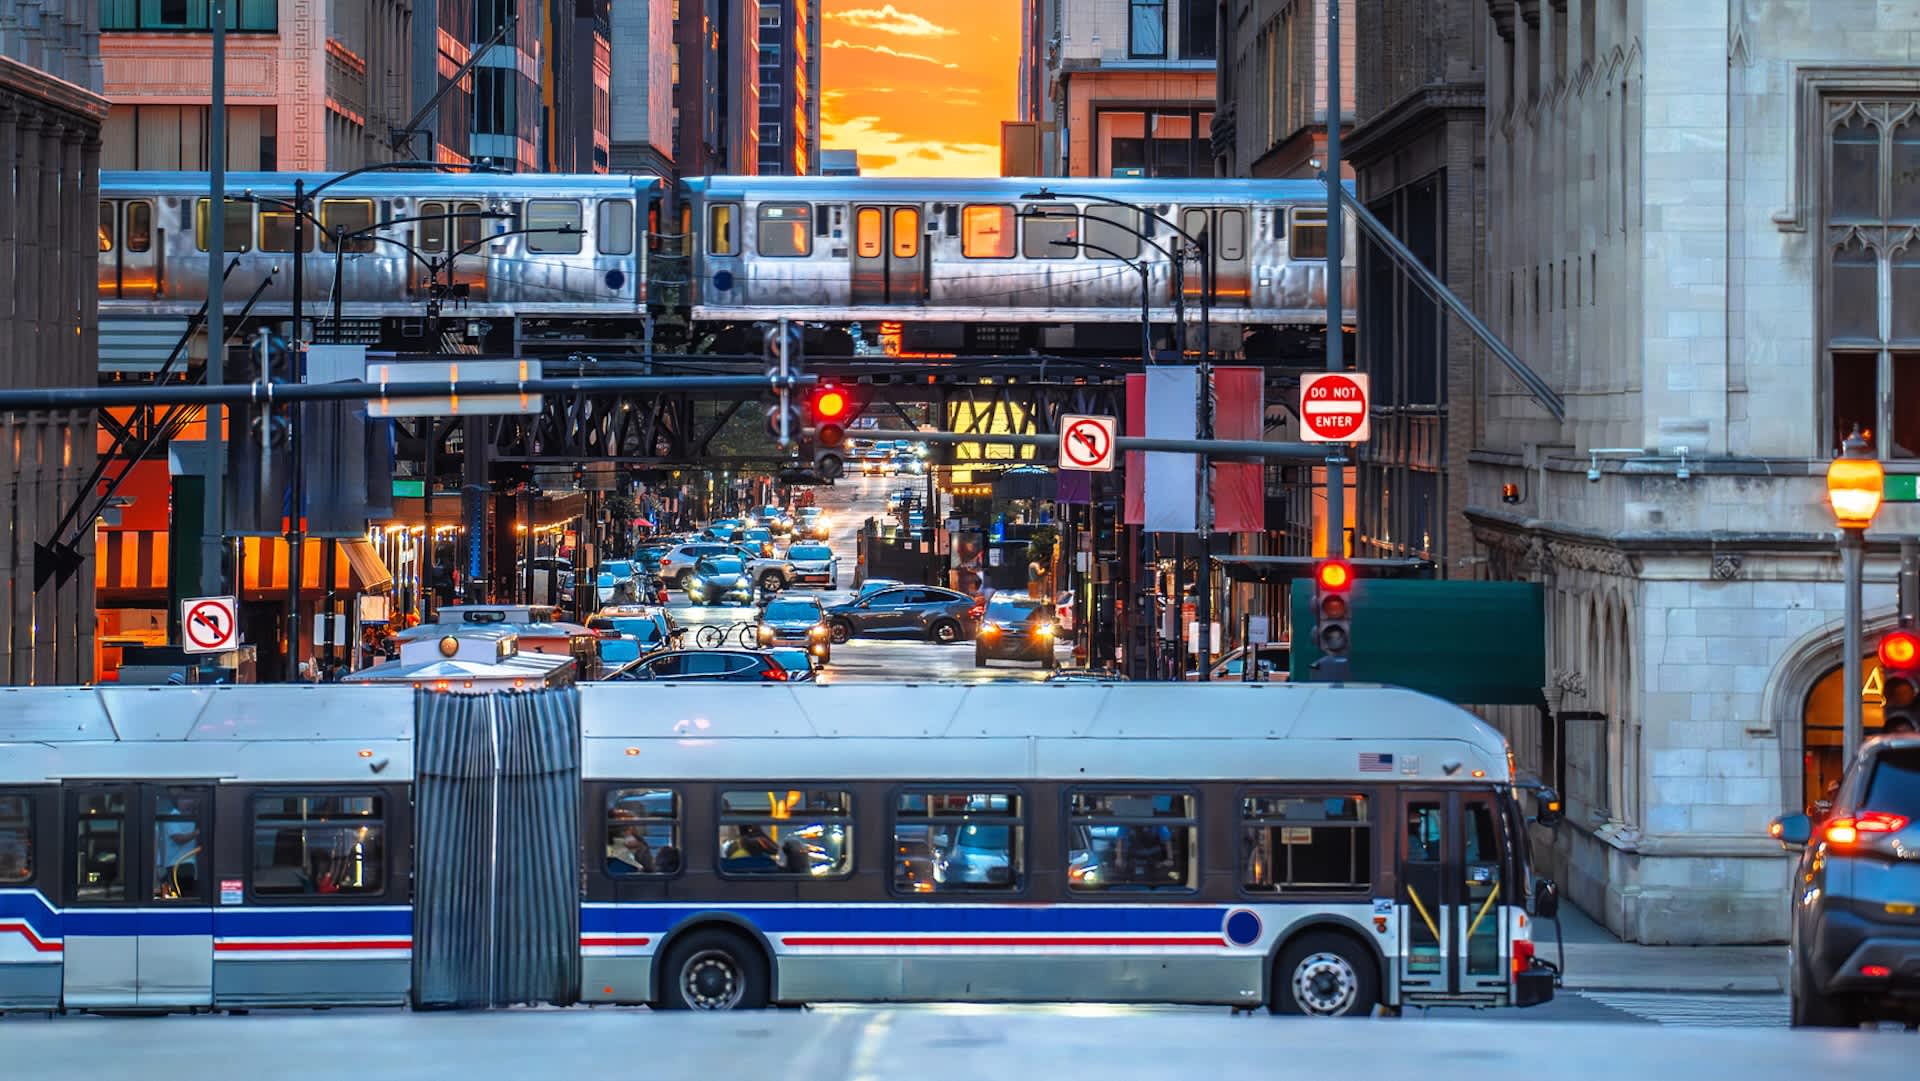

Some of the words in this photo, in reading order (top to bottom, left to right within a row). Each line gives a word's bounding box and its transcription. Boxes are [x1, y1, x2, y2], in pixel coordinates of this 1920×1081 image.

[1311, 387, 1327, 398] DO
[1333, 387, 1356, 398] NOT
[1316, 416, 1353, 427] ENTER
